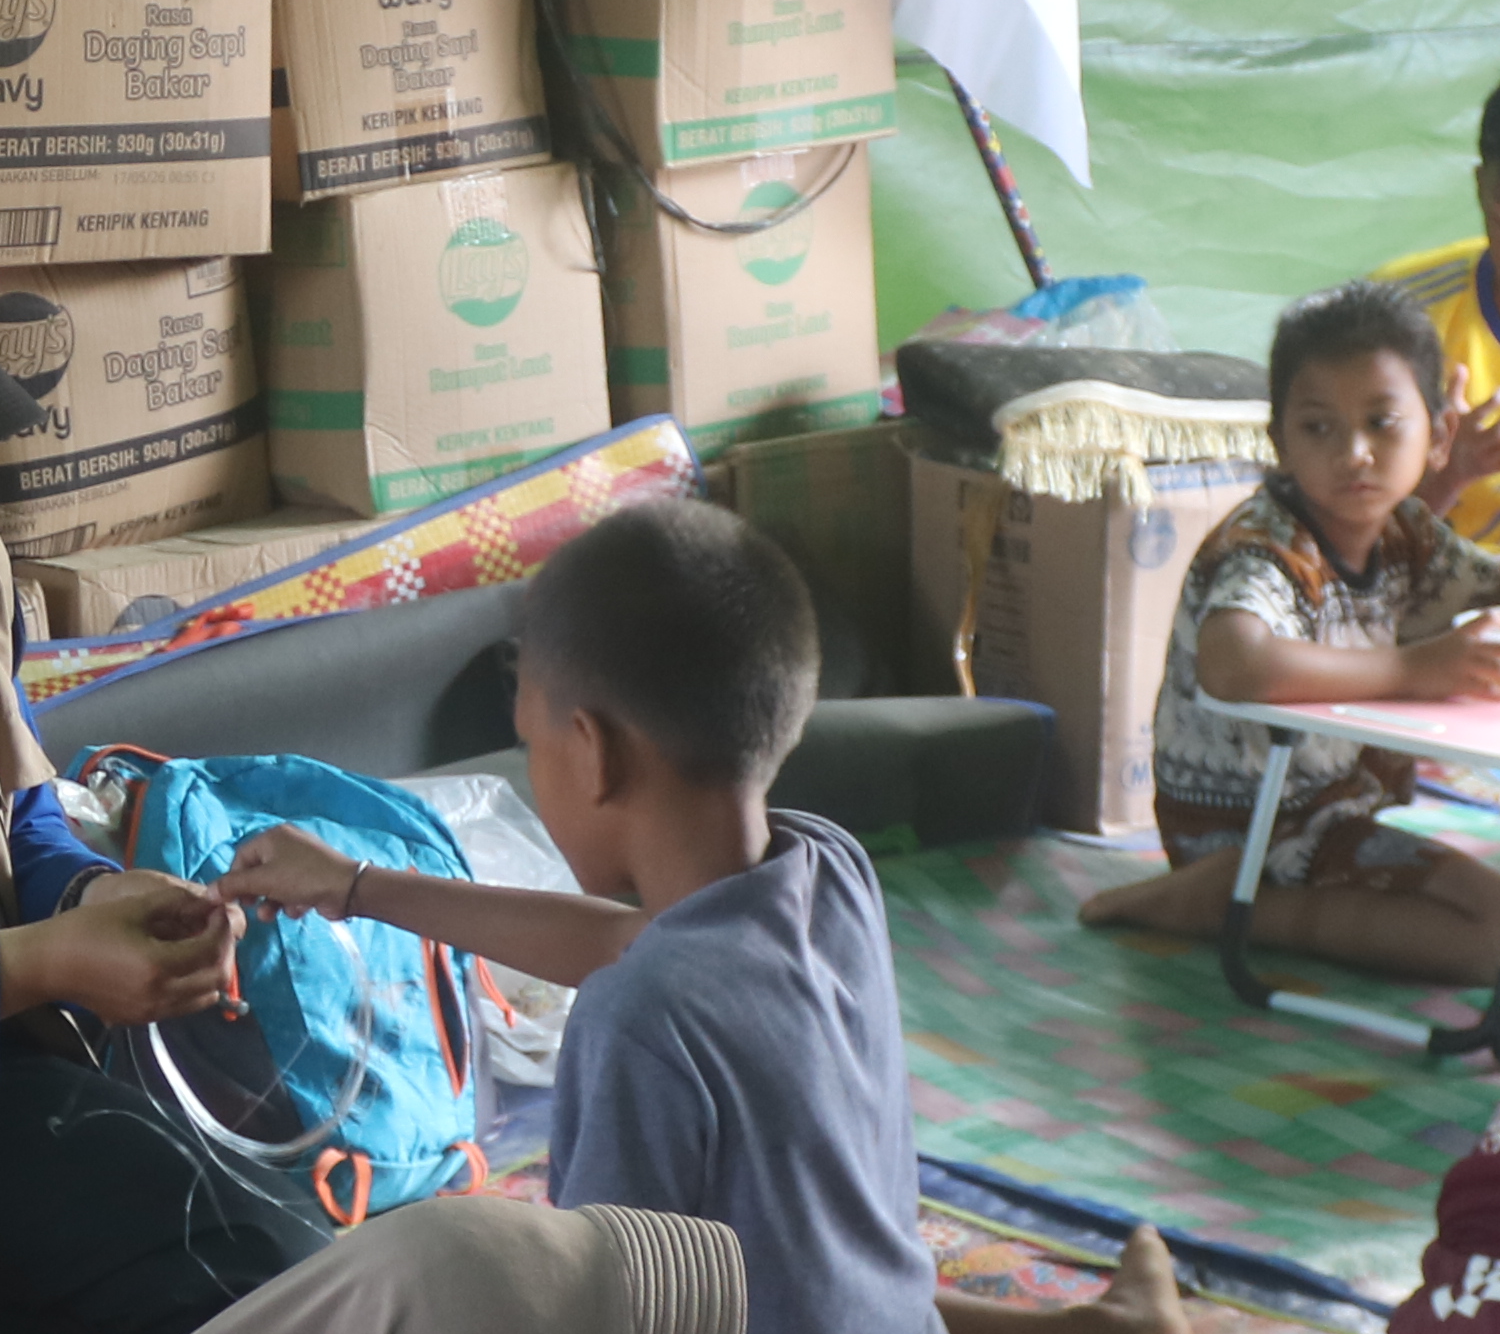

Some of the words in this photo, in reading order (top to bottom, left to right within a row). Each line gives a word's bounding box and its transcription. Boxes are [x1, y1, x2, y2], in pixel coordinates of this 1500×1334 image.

[146, 4, 192, 26] Rasa
[84, 30, 184, 68] Daging
[188, 26, 246, 66] Sapi
[360, 38, 433, 69] Daging
[436, 29, 478, 61] Sapi
[126, 68, 211, 100] Bakar
[393, 65, 455, 92] Bakar
[362, 109, 417, 131] KERIPIK
[422, 97, 483, 122] KENTANG
[46, 135, 112, 156] BERSIH:
[117, 133, 154, 155] 930g
[160, 130, 225, 155] (30x31g)
[41, 169, 101, 183] SEBELUM:
[317, 155, 366, 178] BERAT
[372, 145, 431, 170] BERSIH:
[77, 213, 135, 232] KERIPIK
[140, 210, 209, 229] KENTANG
[160, 313, 204, 338] Rasa
[104, 342, 197, 383] Daging
[146, 368, 222, 411] Bakar
[20, 464, 74, 490] BERAT
[79, 452, 139, 478] BERSIH:
[143, 441, 176, 464] 930g
